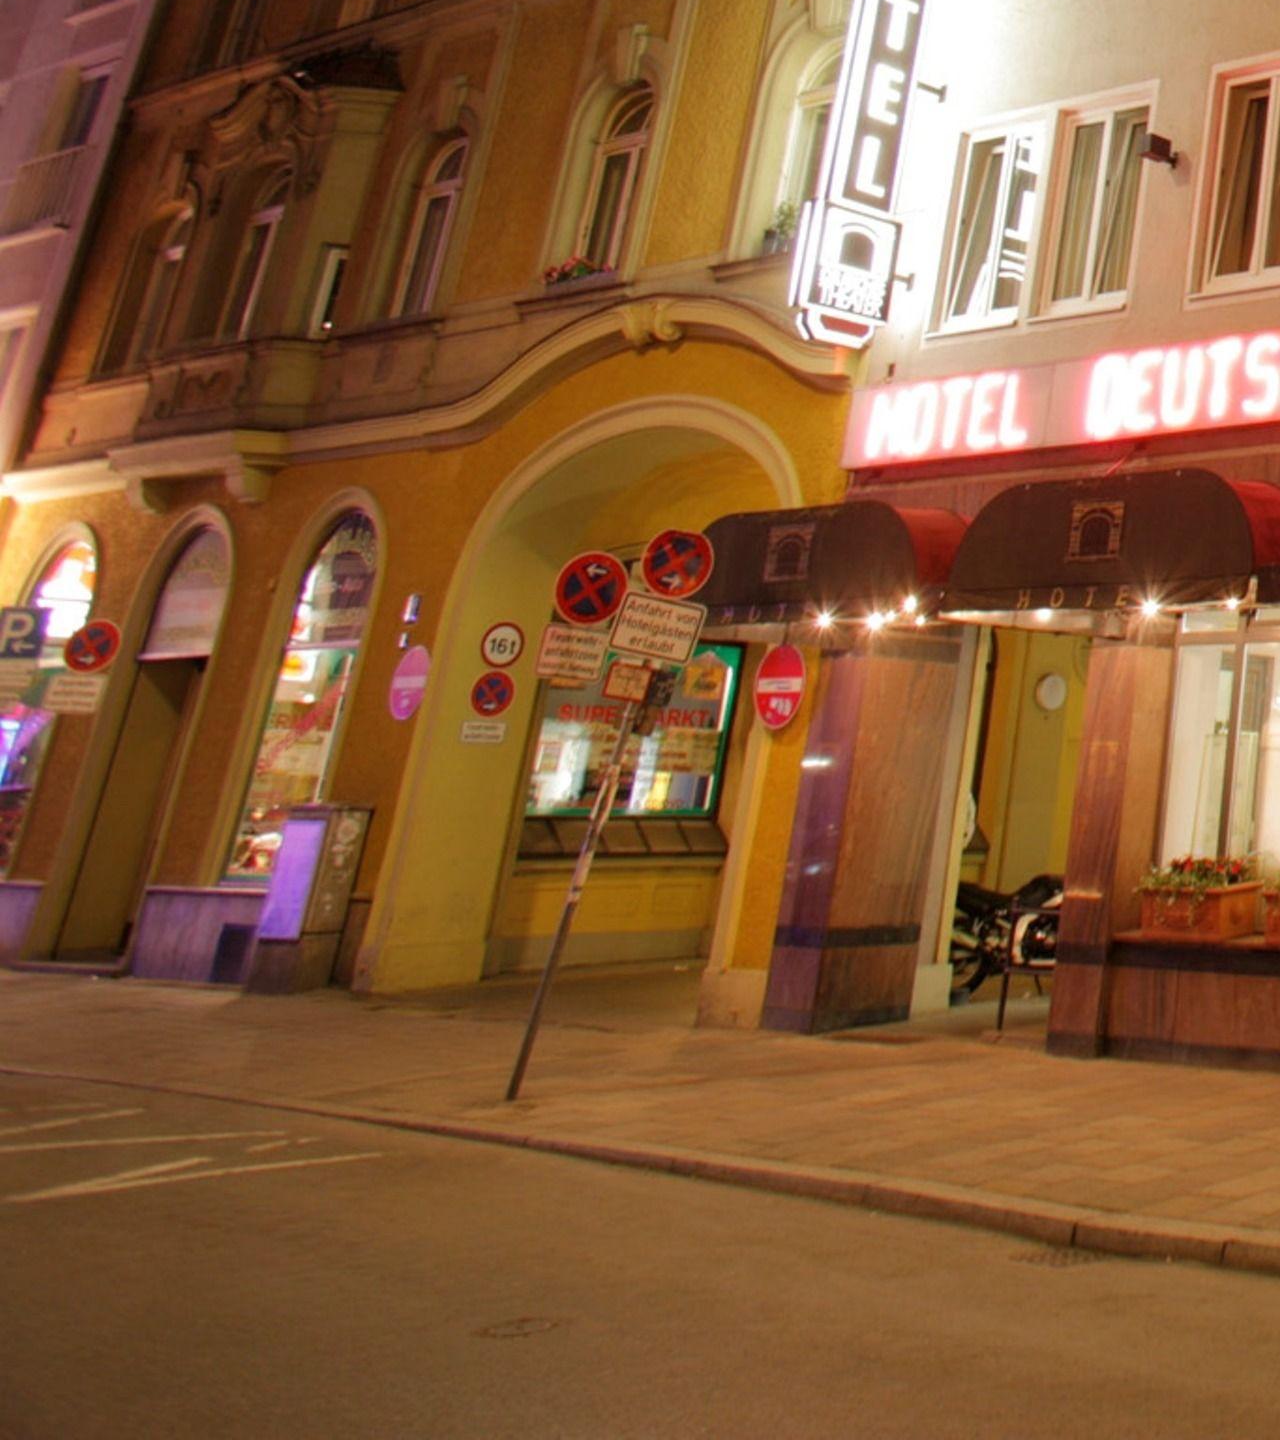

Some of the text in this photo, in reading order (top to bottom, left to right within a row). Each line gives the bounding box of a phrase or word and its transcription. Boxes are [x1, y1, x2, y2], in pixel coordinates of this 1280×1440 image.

[862, 370, 1029, 462] HOTEL
[626, 599, 699, 625] Anfahrt von
[0, 613, 35, 655] P
[629, 635, 676, 652] erlaubt
